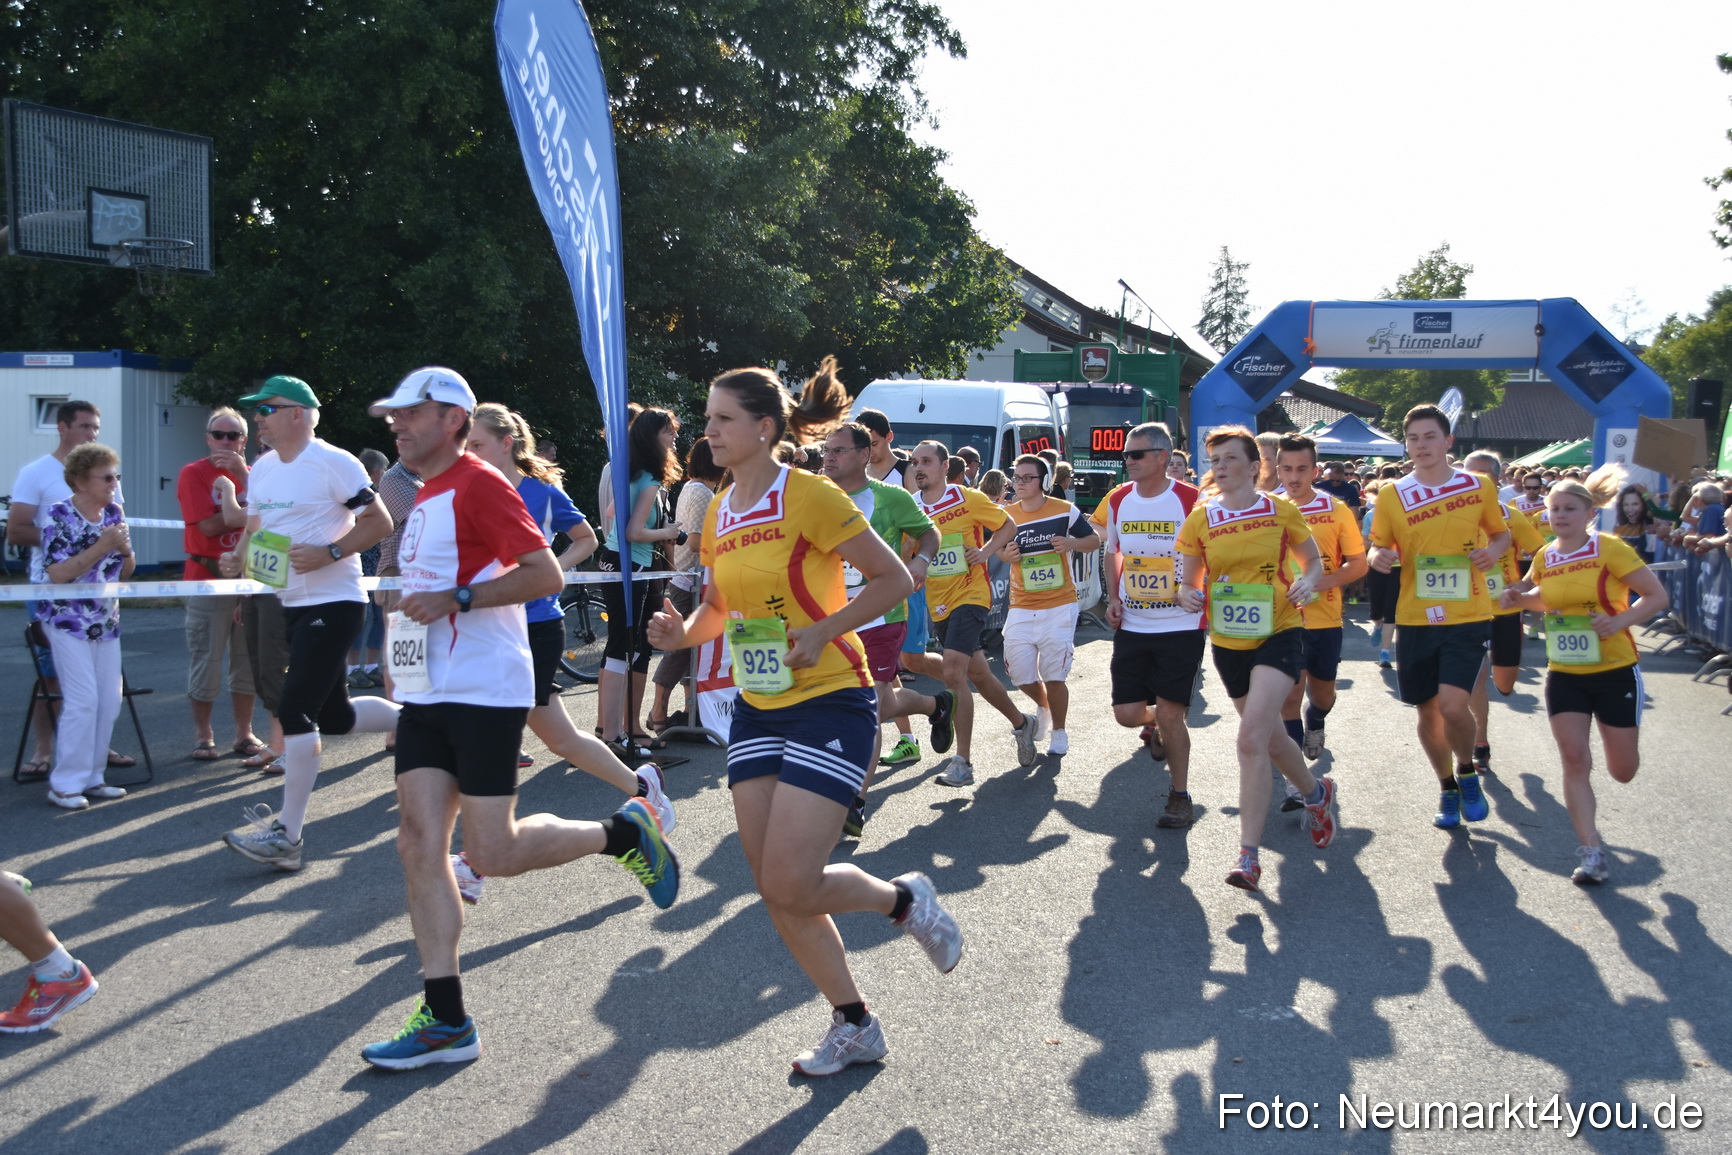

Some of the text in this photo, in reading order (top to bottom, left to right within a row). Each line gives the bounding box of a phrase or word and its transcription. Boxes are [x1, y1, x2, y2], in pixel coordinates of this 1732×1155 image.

[1399, 334, 1485, 349] firmenlauf
[1242, 362, 1286, 372] Fischer
[937, 506, 970, 526] BÖGL
[1406, 494, 1483, 527] MAX BÖGL
[1122, 522, 1170, 533] ONLINE
[1305, 515, 1335, 525] ÖGL
[1147, 533, 1175, 541] Germany
[1208, 519, 1279, 540] MAX BÖGL
[715, 527, 786, 557] MAX BÖGL
[1020, 532, 1057, 546] Fischer
[253, 549, 279, 573] 112
[931, 550, 958, 567] 920
[1567, 560, 1601, 574] BÖGL
[1029, 567, 1056, 582] 454
[1128, 573, 1168, 590] 1021
[1425, 572, 1458, 589] 911
[1222, 604, 1261, 624] 926
[1557, 634, 1589, 651] 890
[392, 638, 424, 668] 8924
[743, 649, 780, 675] 925
